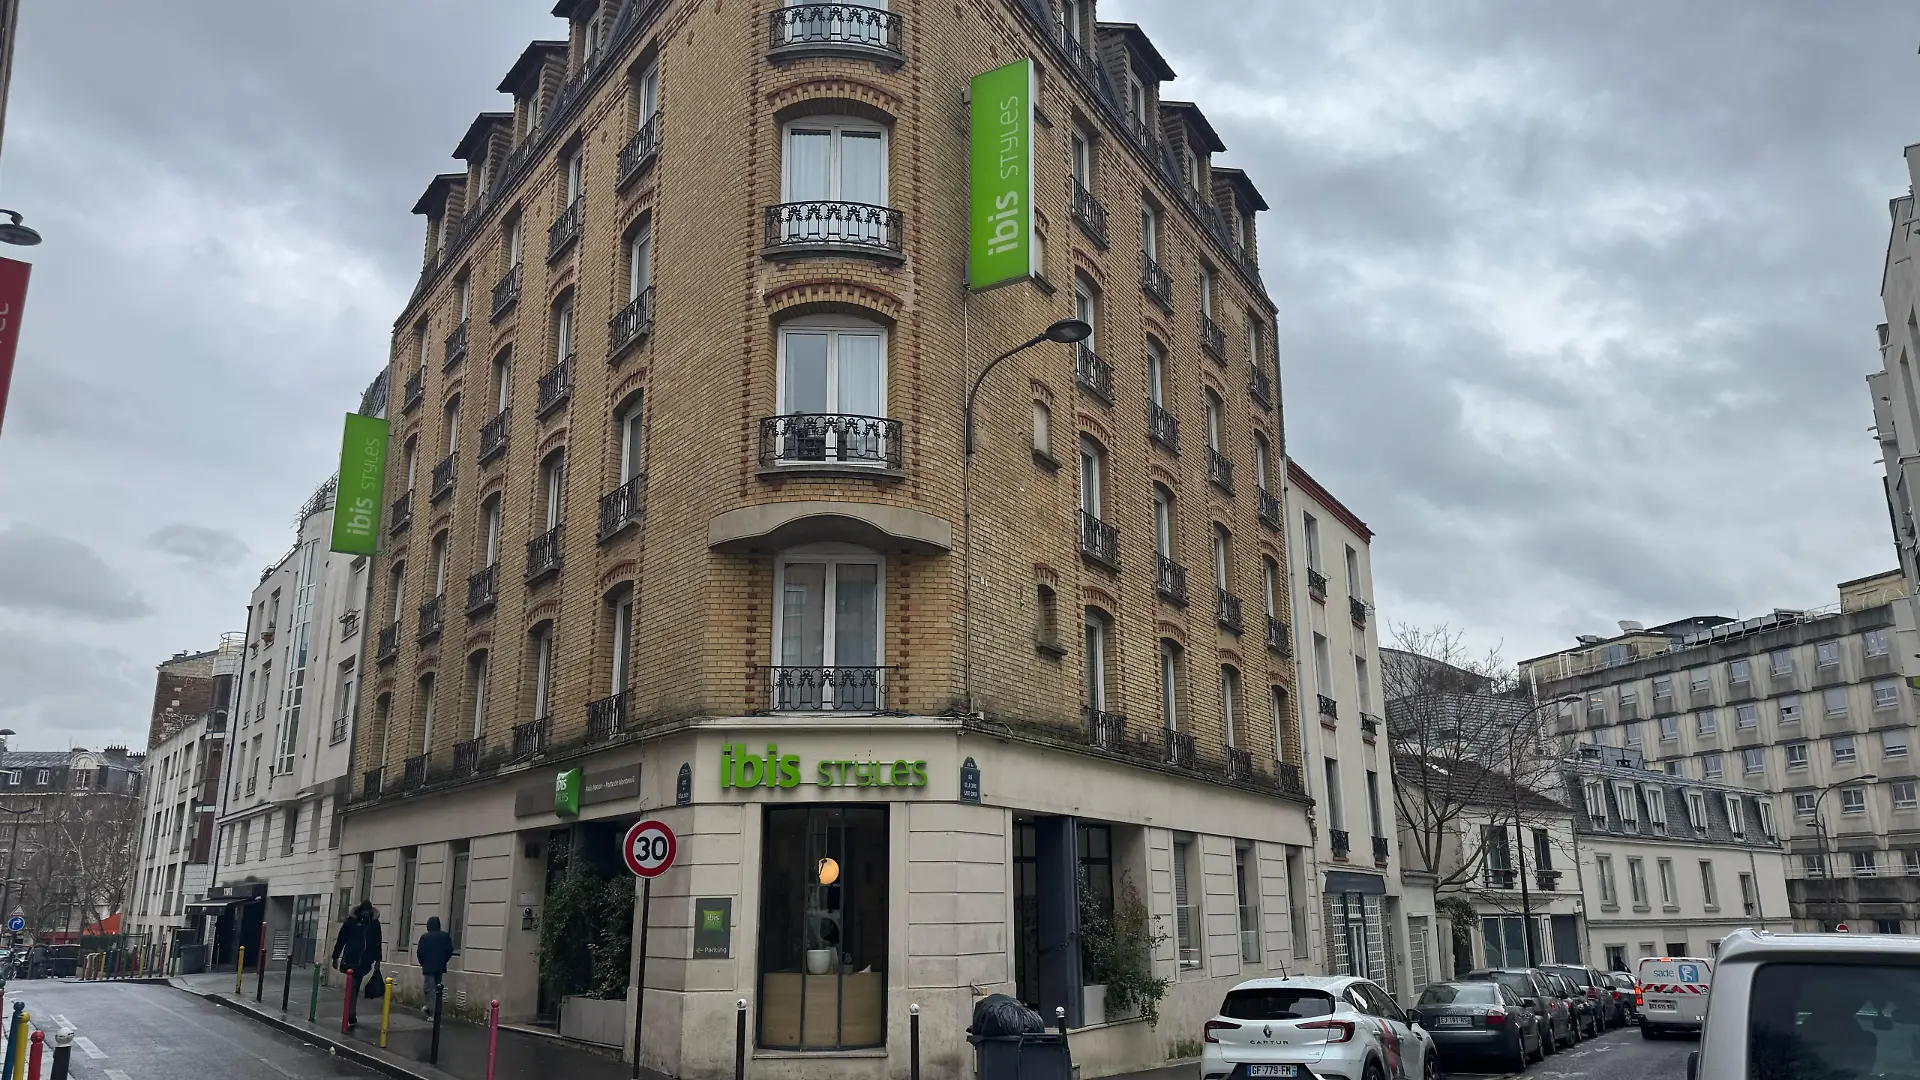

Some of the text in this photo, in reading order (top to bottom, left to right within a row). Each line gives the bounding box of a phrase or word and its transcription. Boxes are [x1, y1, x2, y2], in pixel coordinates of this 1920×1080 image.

[988, 190, 1019, 256] ibis
[346, 497, 373, 536] ibis
[720, 743, 801, 788] ibis
[635, 836, 668, 862] 30
[704, 946, 728, 954] Parking
[1653, 968, 1675, 978] sade
